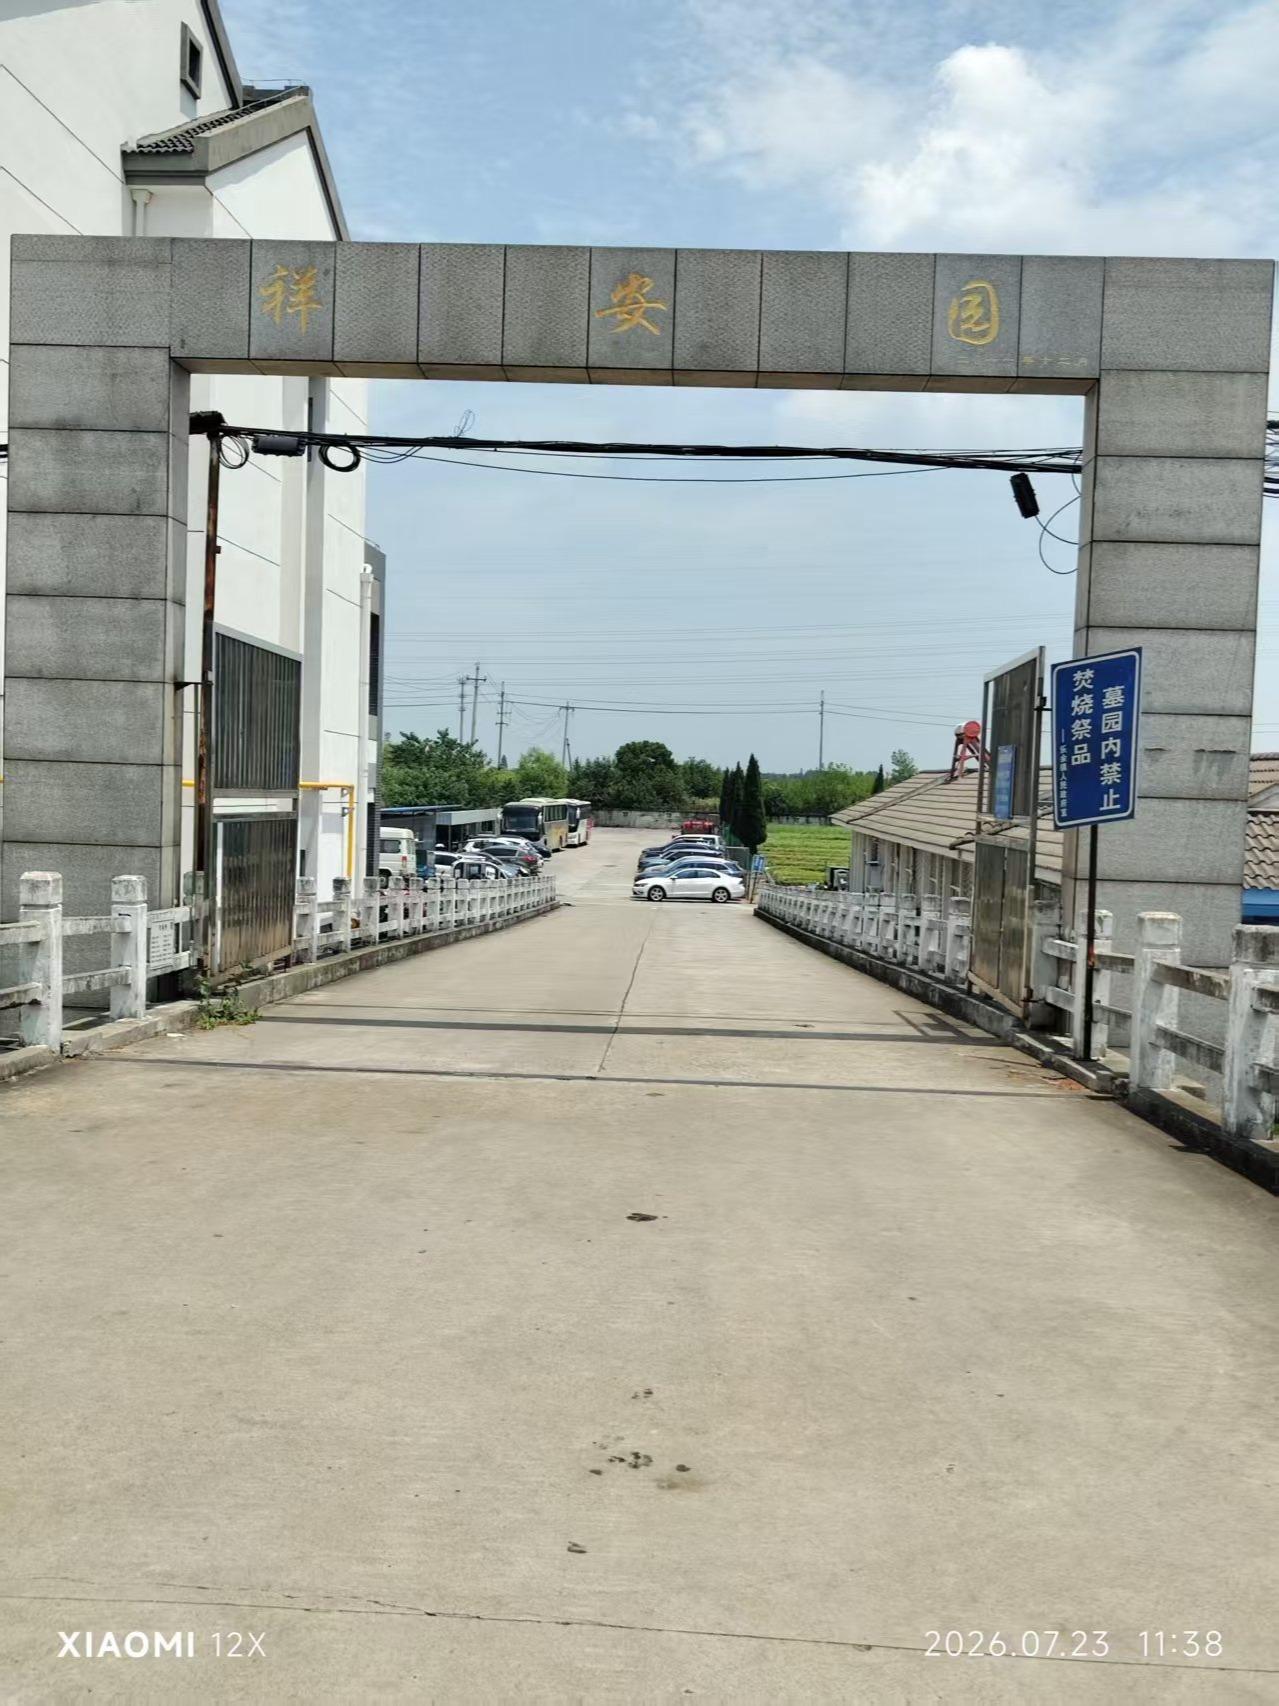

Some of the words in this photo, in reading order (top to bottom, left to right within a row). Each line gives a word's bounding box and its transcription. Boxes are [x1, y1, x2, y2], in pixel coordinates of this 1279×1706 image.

[1071, 668, 1095, 766] 焚烧祭品
[1099, 685, 1125, 812] 墓园内禁止
